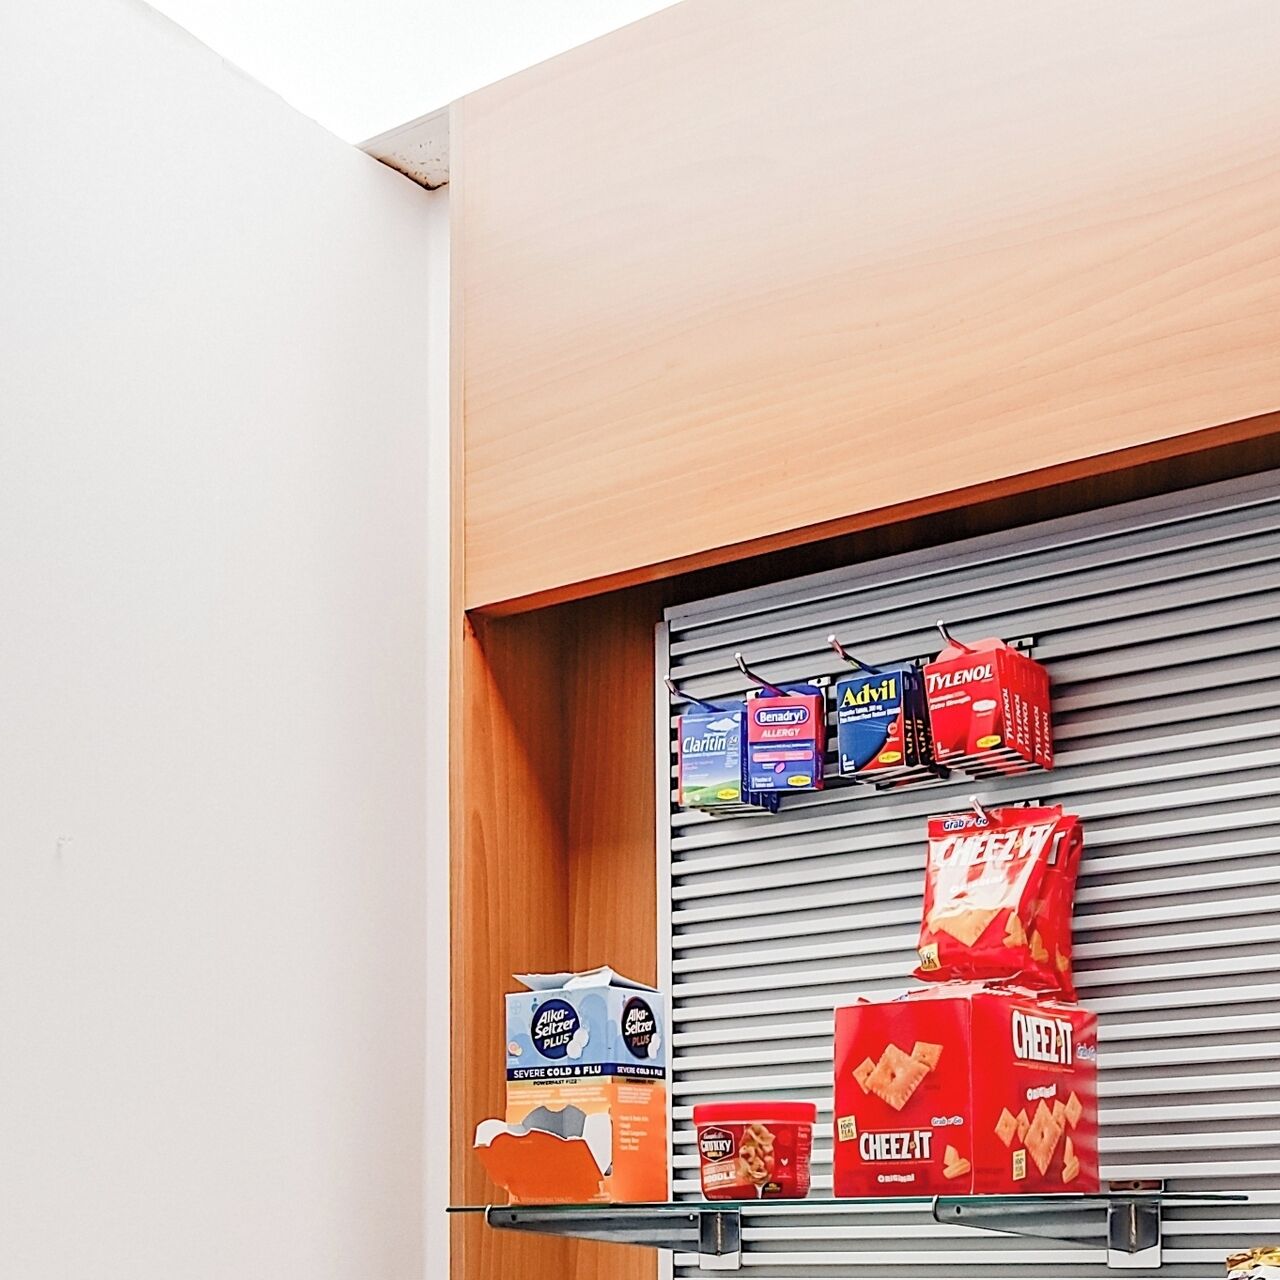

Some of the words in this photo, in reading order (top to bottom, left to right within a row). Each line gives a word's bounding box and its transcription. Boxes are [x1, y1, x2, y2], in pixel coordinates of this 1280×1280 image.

[926, 664, 994, 694] TYLENOL
[840, 678, 897, 709] Advil
[759, 709, 804, 725] Benadryl
[1002, 688, 1014, 740] TYLENOL
[760, 728, 801, 739] ALLERGY
[682, 732, 727, 753] Claritin
[537, 1008, 569, 1025] Alka-
[626, 1008, 649, 1022] Alka-
[535, 1018, 576, 1040] Seltzer
[625, 1019, 654, 1036] Seltzer
[543, 1033, 571, 1050] PLUS
[631, 1034, 650, 1047] PLUS
[513, 1069, 546, 1079] SEVERE
[547, 1066, 572, 1076] COLD
[574, 1066, 581, 1075] &
[583, 1065, 602, 1075] FLU
[617, 1066, 636, 1074] SEVERE
[636, 1066, 650, 1075] COLD
